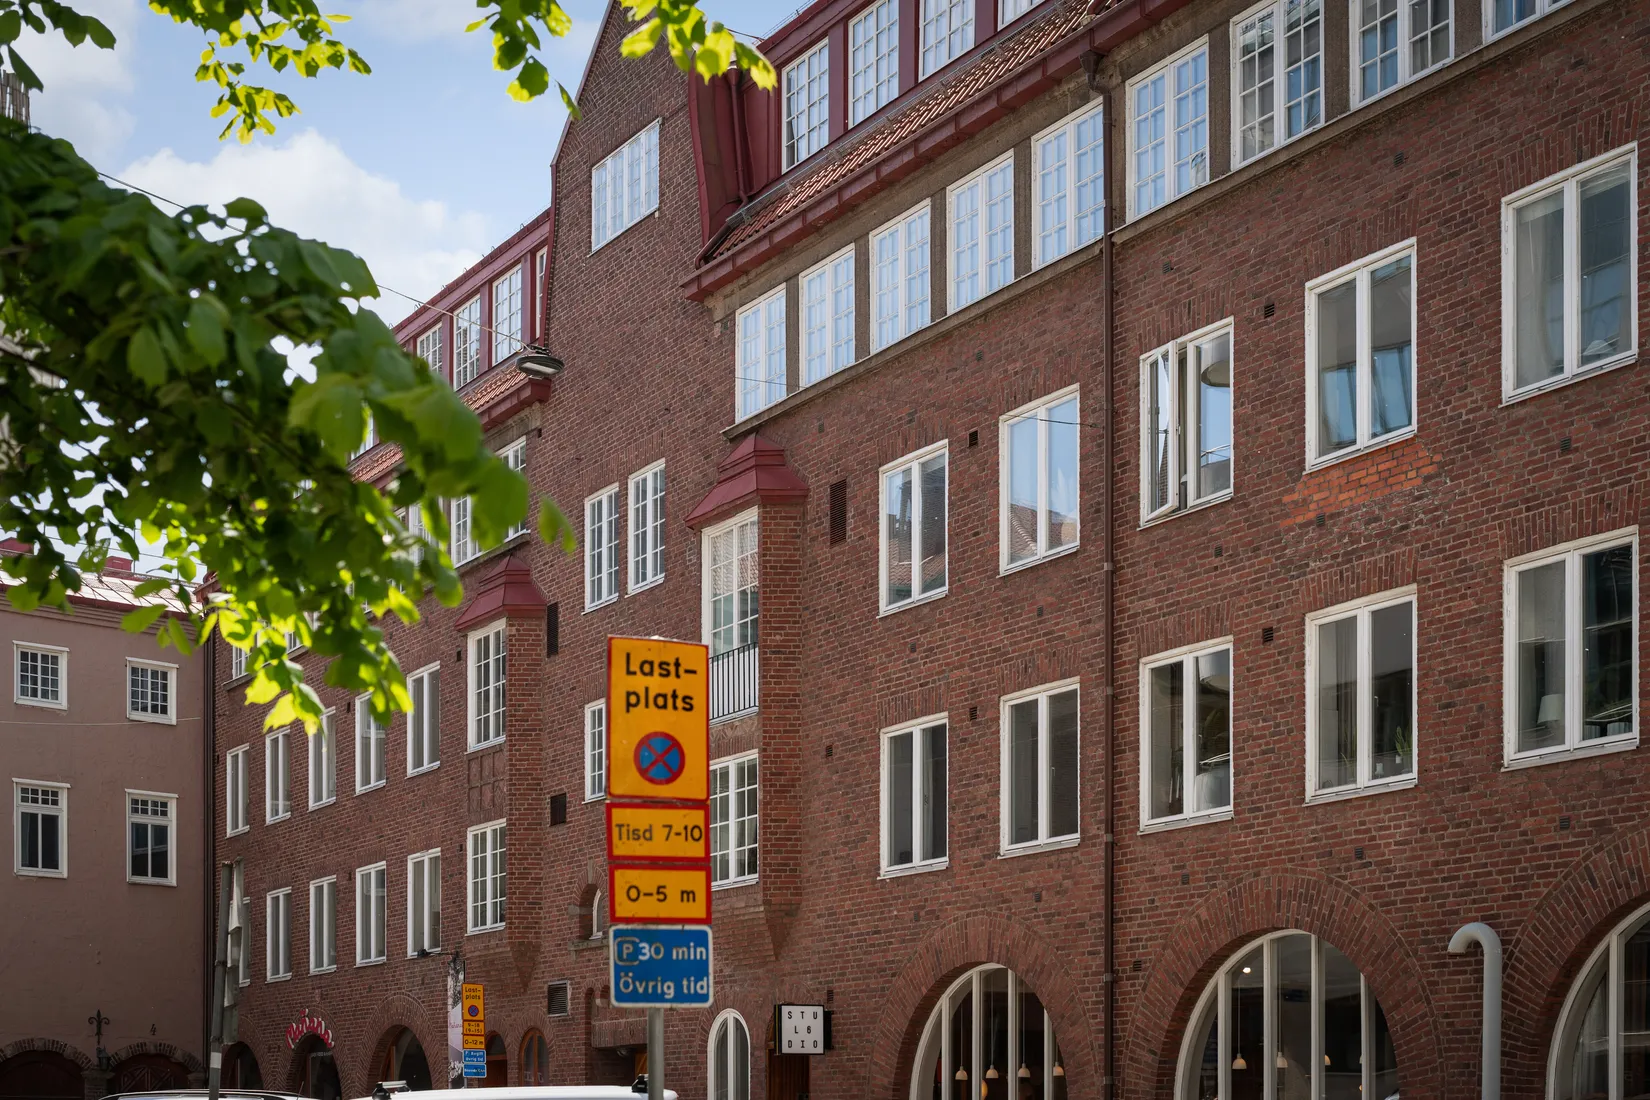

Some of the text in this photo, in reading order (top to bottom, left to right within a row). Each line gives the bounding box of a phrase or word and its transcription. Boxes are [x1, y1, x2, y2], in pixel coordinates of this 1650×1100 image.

[625, 652, 697, 679] Last-
[625, 686, 694, 713] plats
[615, 823, 703, 843] Tisd 7-10
[626, 885, 696, 903] 0-5 m
[672, 942, 707, 961] min
[619, 972, 708, 999] Övrig tid
[150, 1023, 157, 1036] 4
